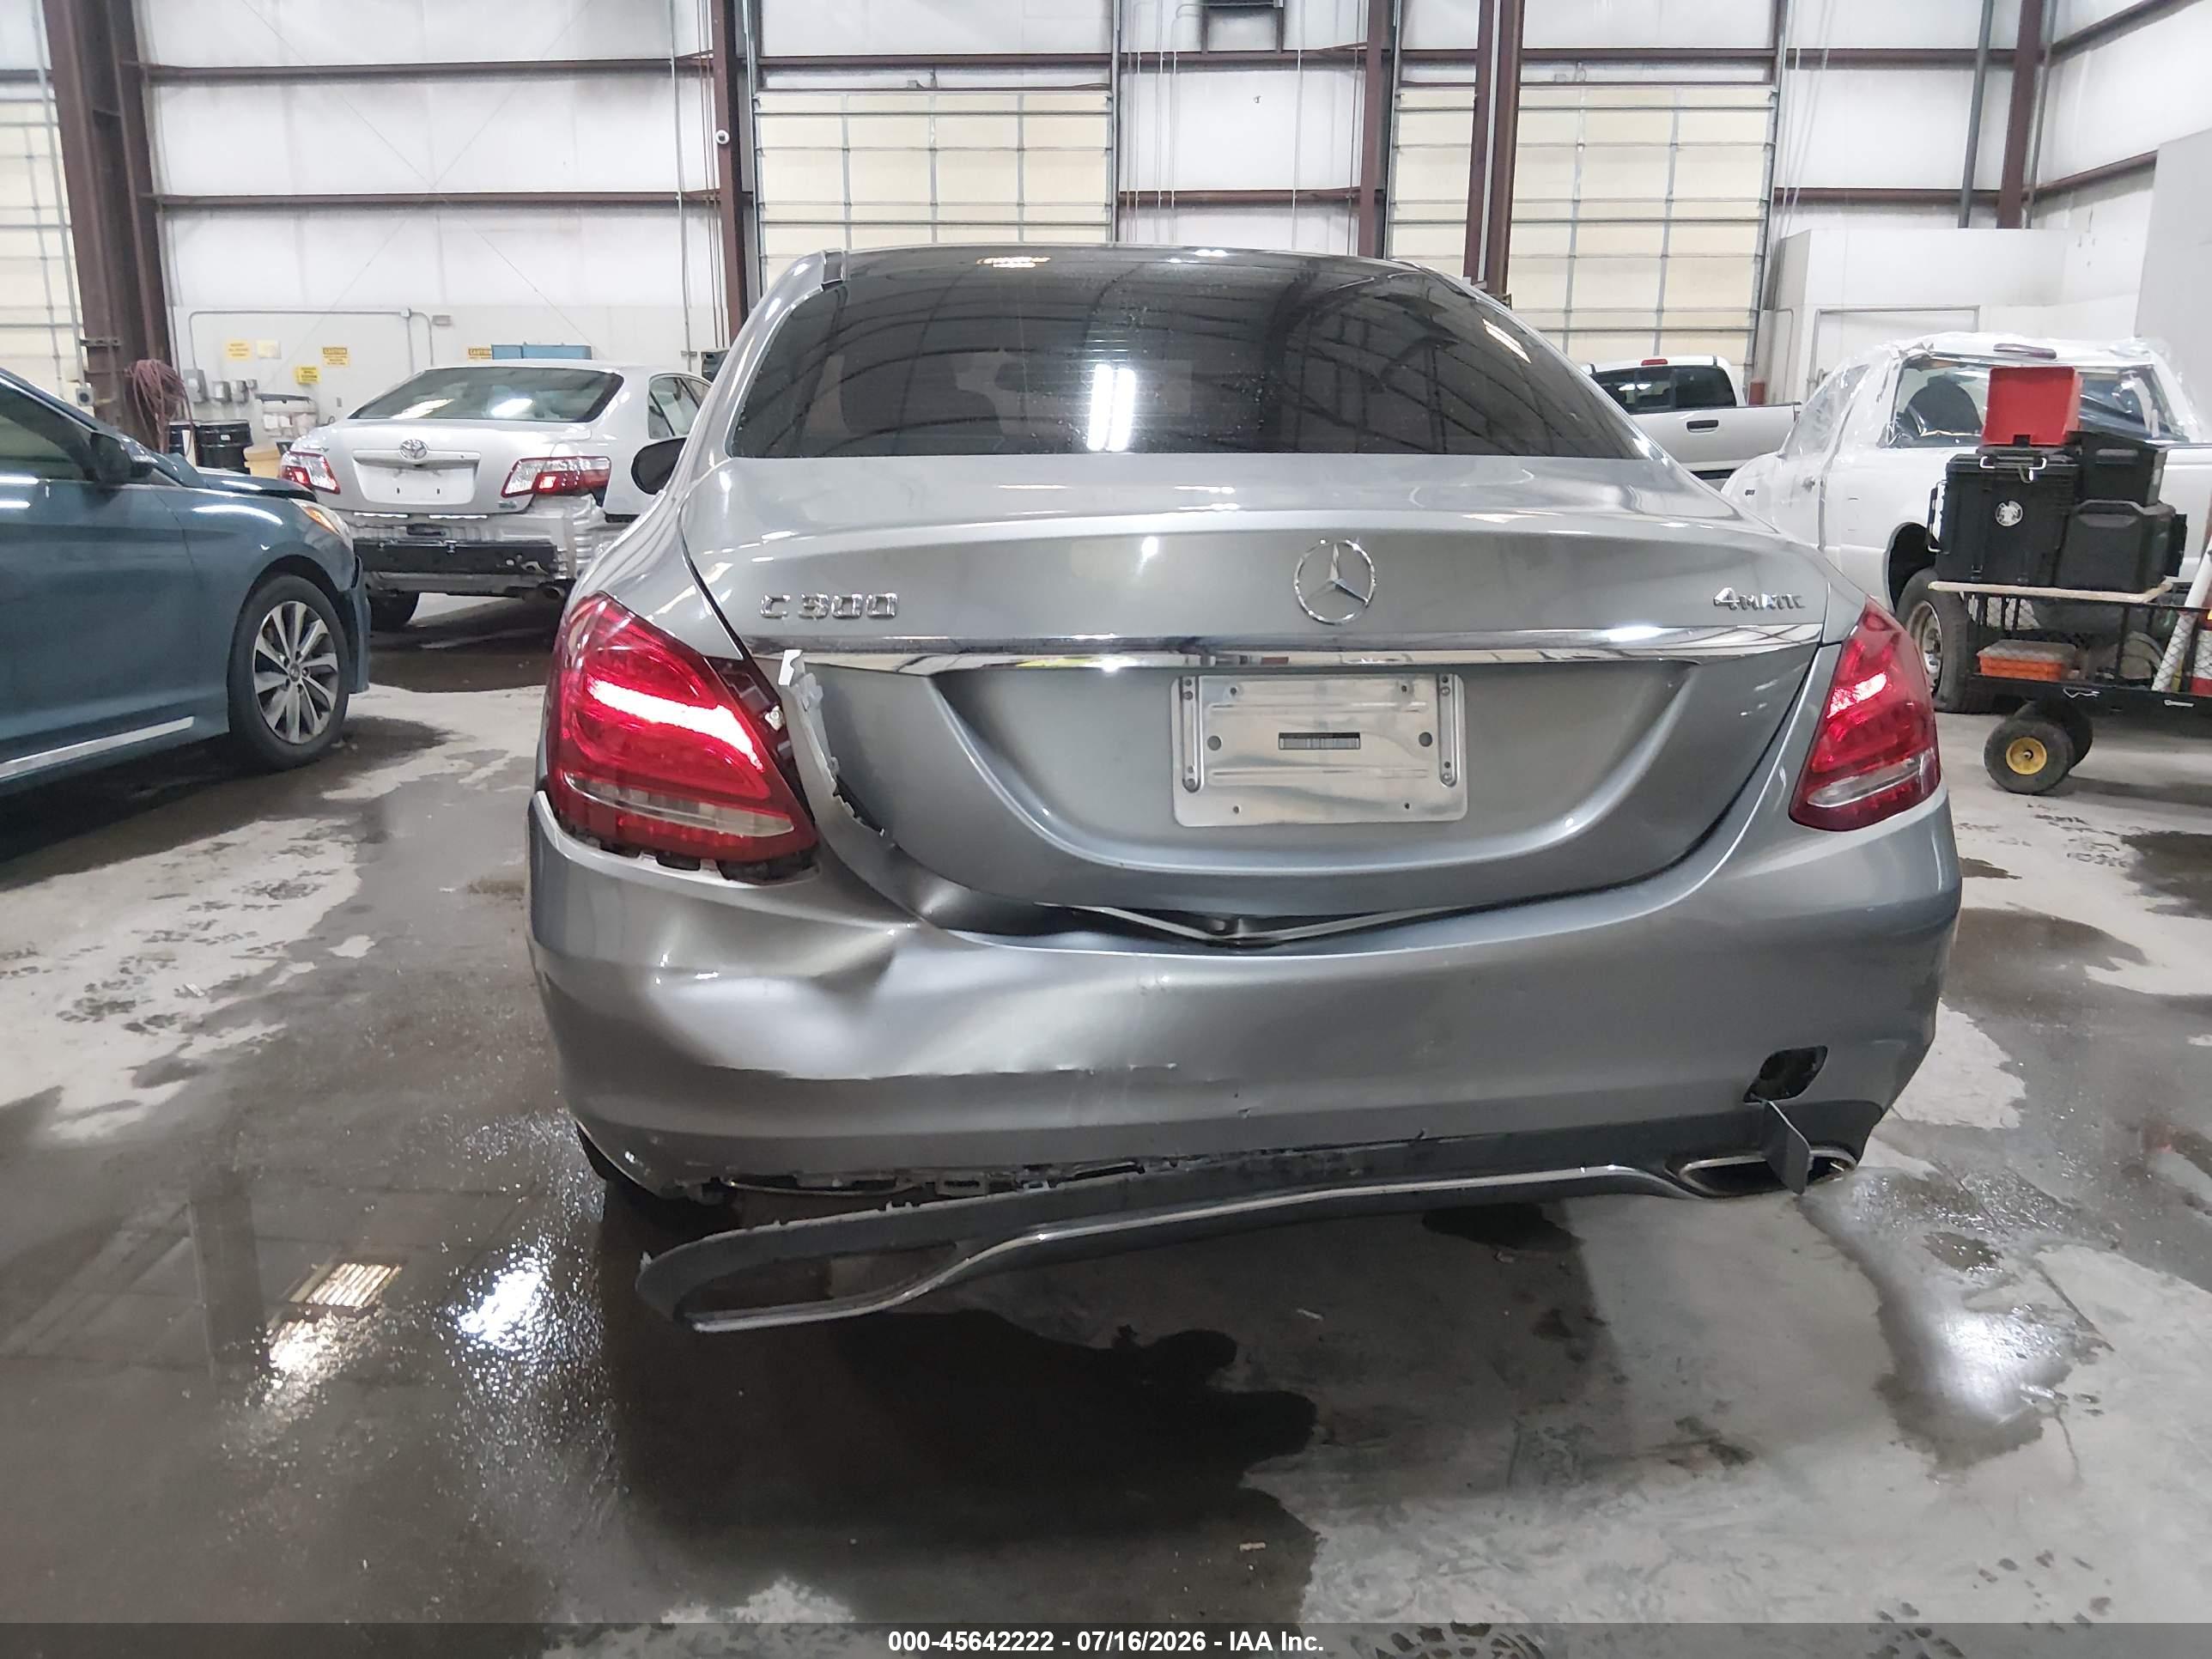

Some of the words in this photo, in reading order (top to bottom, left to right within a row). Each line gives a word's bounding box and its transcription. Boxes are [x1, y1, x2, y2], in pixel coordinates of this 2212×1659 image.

[760, 593, 791, 619] C
[798, 592, 898, 620] 300
[1713, 587, 1805, 611] 4MATIC
